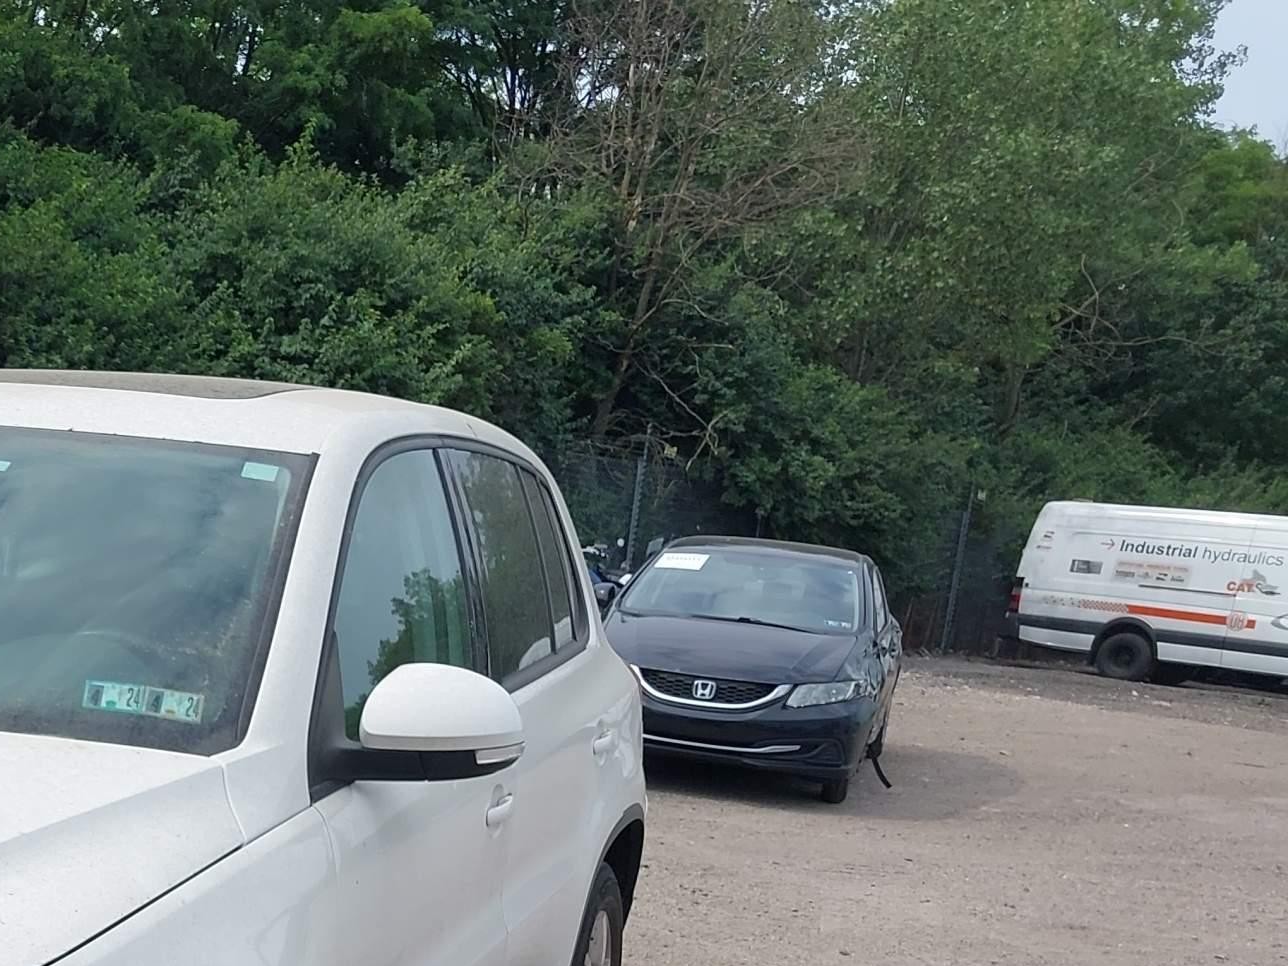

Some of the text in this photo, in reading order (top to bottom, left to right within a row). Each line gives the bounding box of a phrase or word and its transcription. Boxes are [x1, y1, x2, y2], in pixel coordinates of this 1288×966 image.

[1119, 539, 1285, 567] Industrial hydraulics
[126, 687, 141, 709] 24
